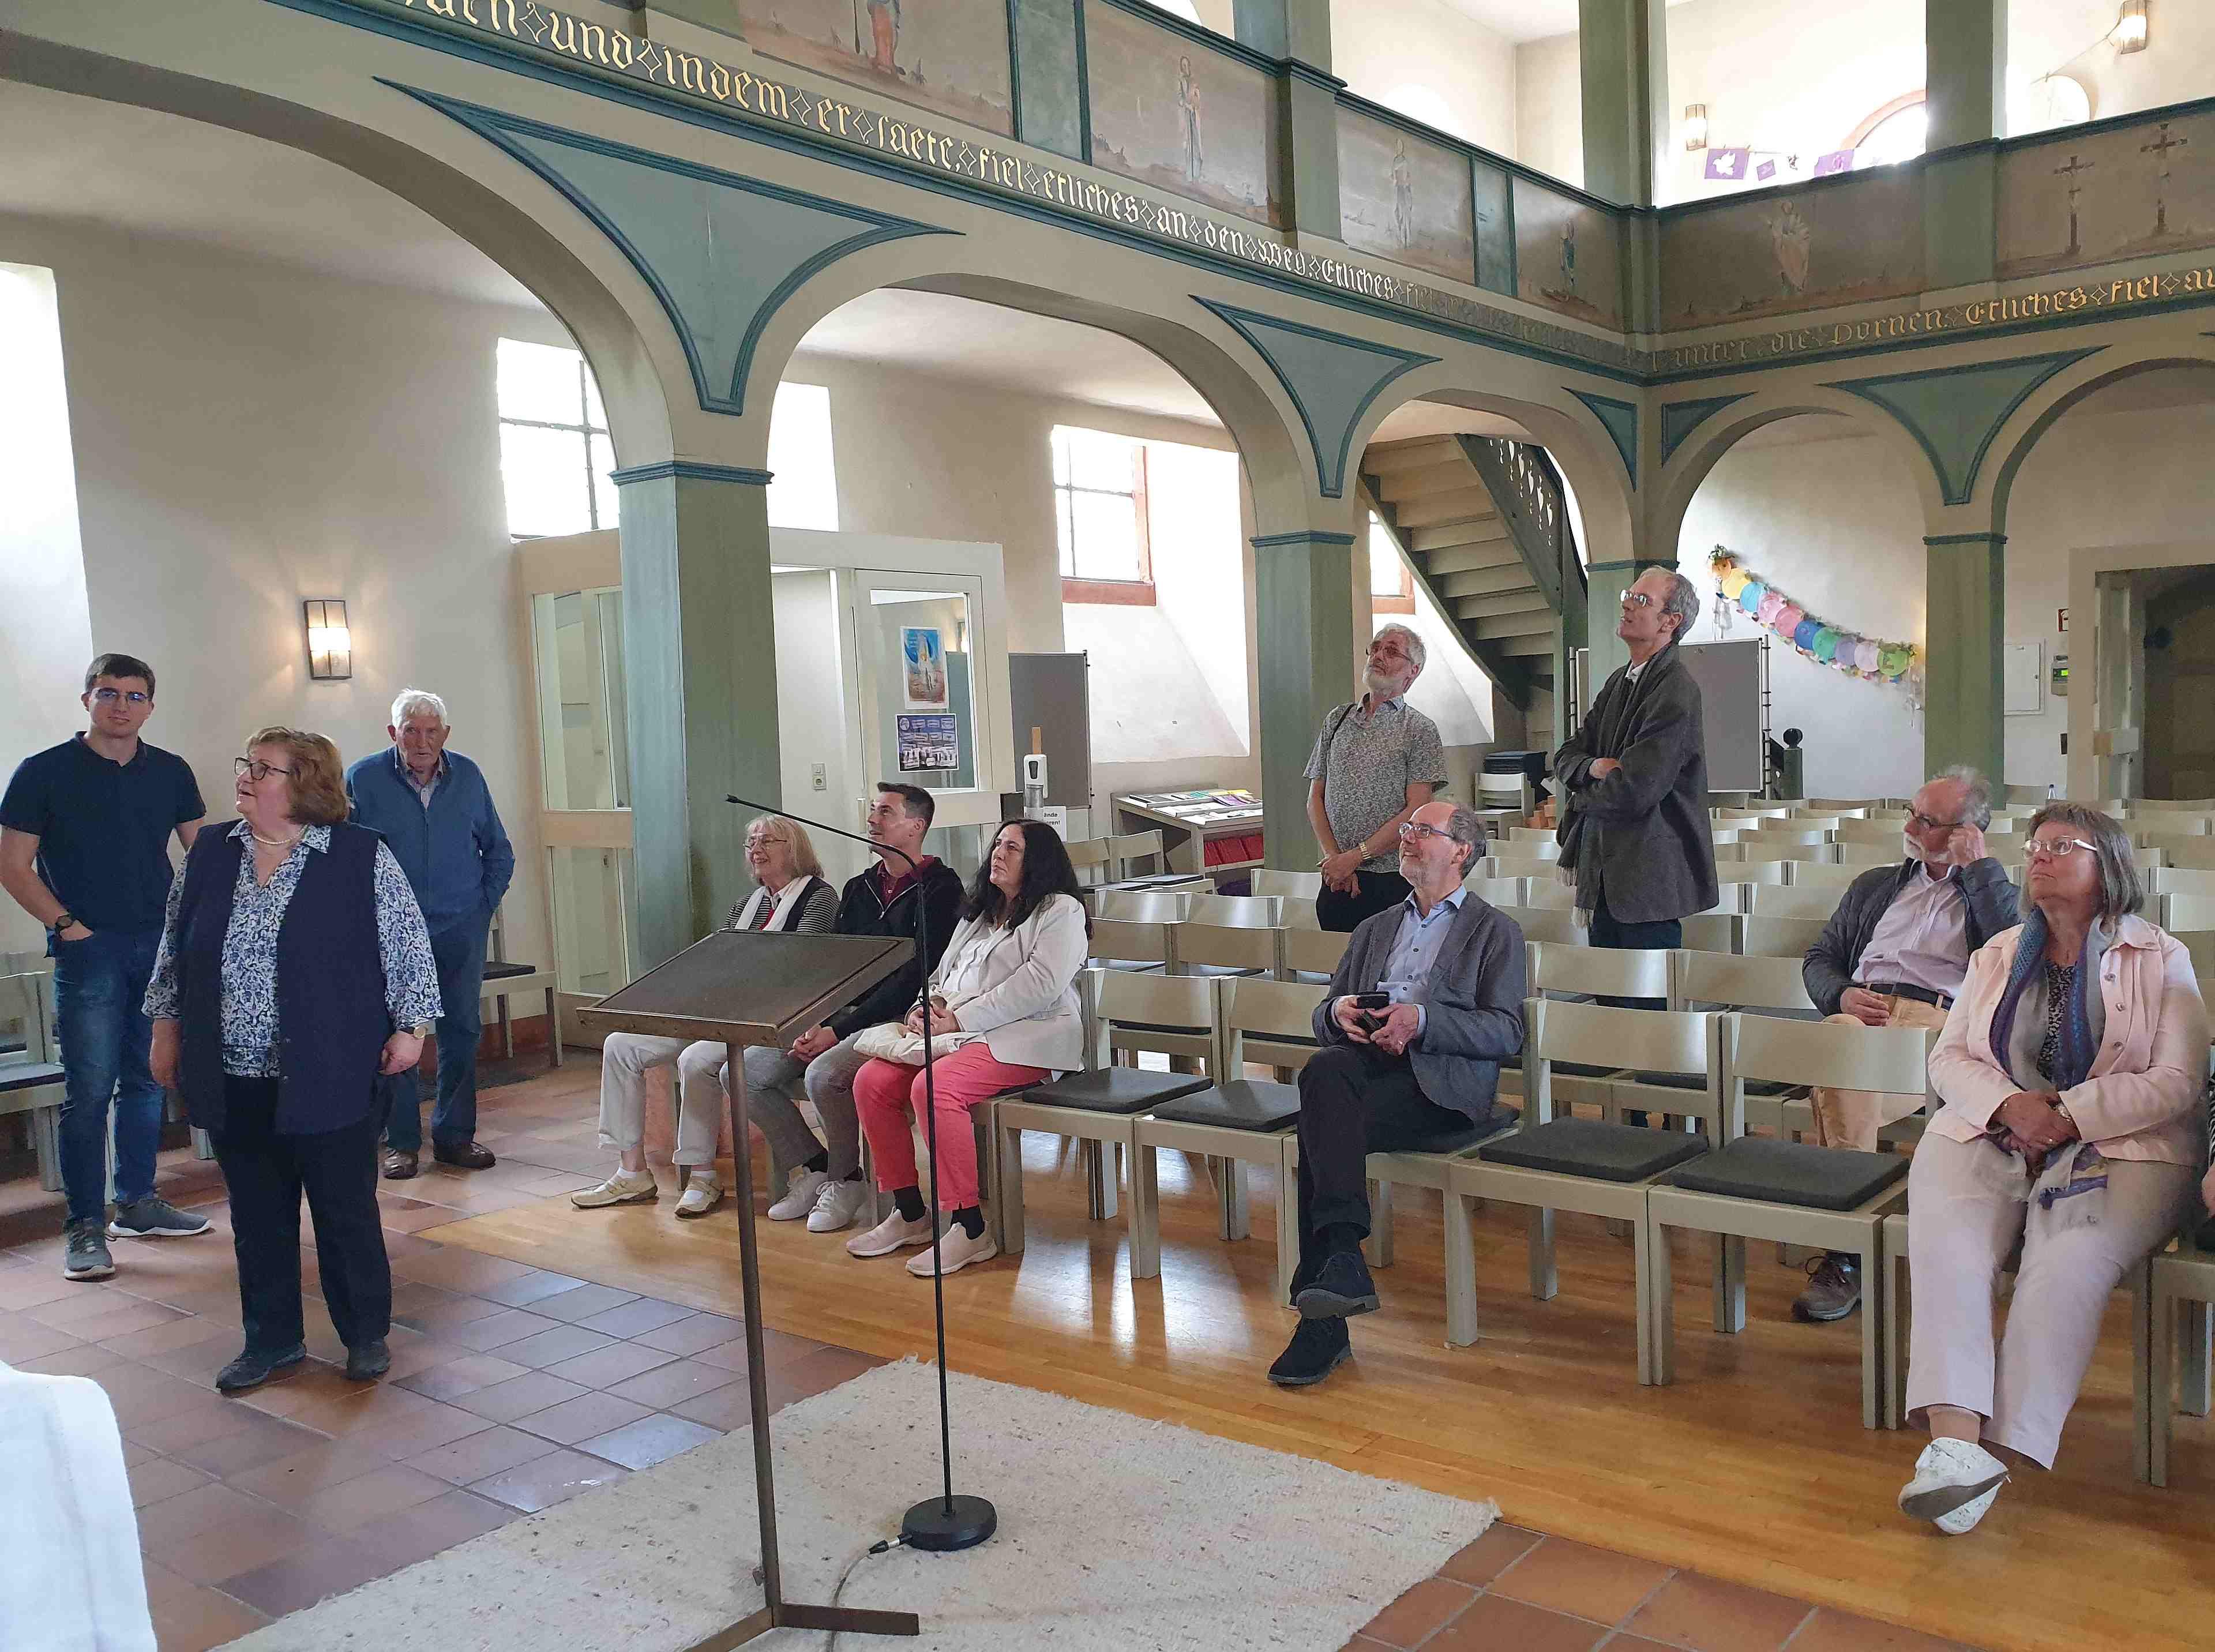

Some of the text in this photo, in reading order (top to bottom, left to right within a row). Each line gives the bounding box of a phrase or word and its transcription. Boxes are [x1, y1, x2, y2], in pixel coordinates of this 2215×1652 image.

[548, 11, 633, 69] und
[663, 46, 790, 119] indem
[817, 98, 852, 136] er
[979, 148, 1024, 192] fiel
[1042, 170, 1139, 223] etliches
[1156, 206, 1188, 239] an
[1204, 220, 1245, 257] den
[1322, 259, 1394, 300] Etliches
[1965, 286, 2087, 325] Etliches
[2111, 275, 2159, 304] fiel
